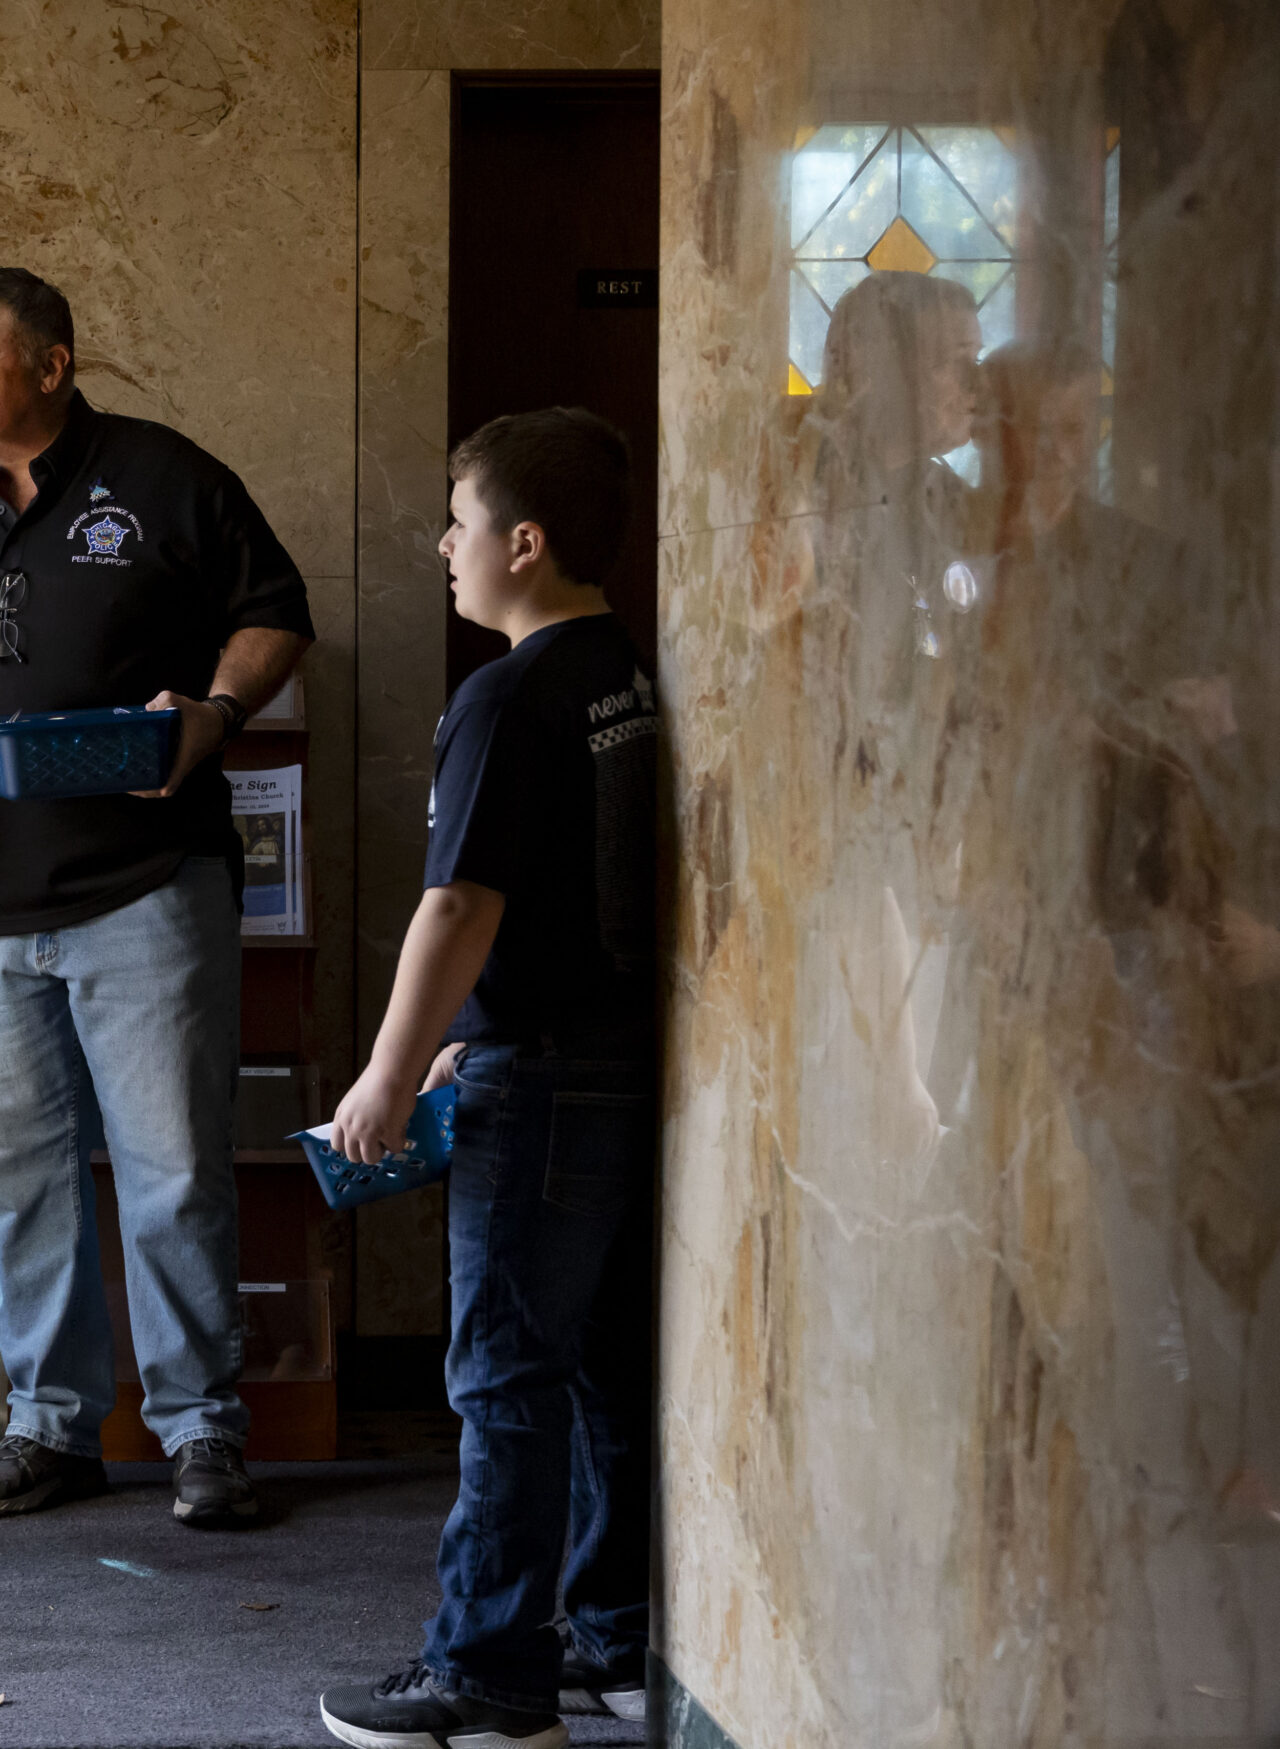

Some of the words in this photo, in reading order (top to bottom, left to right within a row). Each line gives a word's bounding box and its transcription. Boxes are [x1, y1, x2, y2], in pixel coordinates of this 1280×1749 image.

[596, 280, 642, 295] REST
[67, 512, 90, 540] EMPLOYEE
[90, 506, 129, 517] ASSISTANCE
[127, 513, 144, 542] PROGRAM
[91, 522, 121, 535] CHICAGO
[90, 540, 120, 551] POLICE
[71, 555, 93, 563] PEER
[95, 556, 133, 567] SUPPORT
[247, 780, 277, 793] Sign
[260, 792, 284, 800] Church
